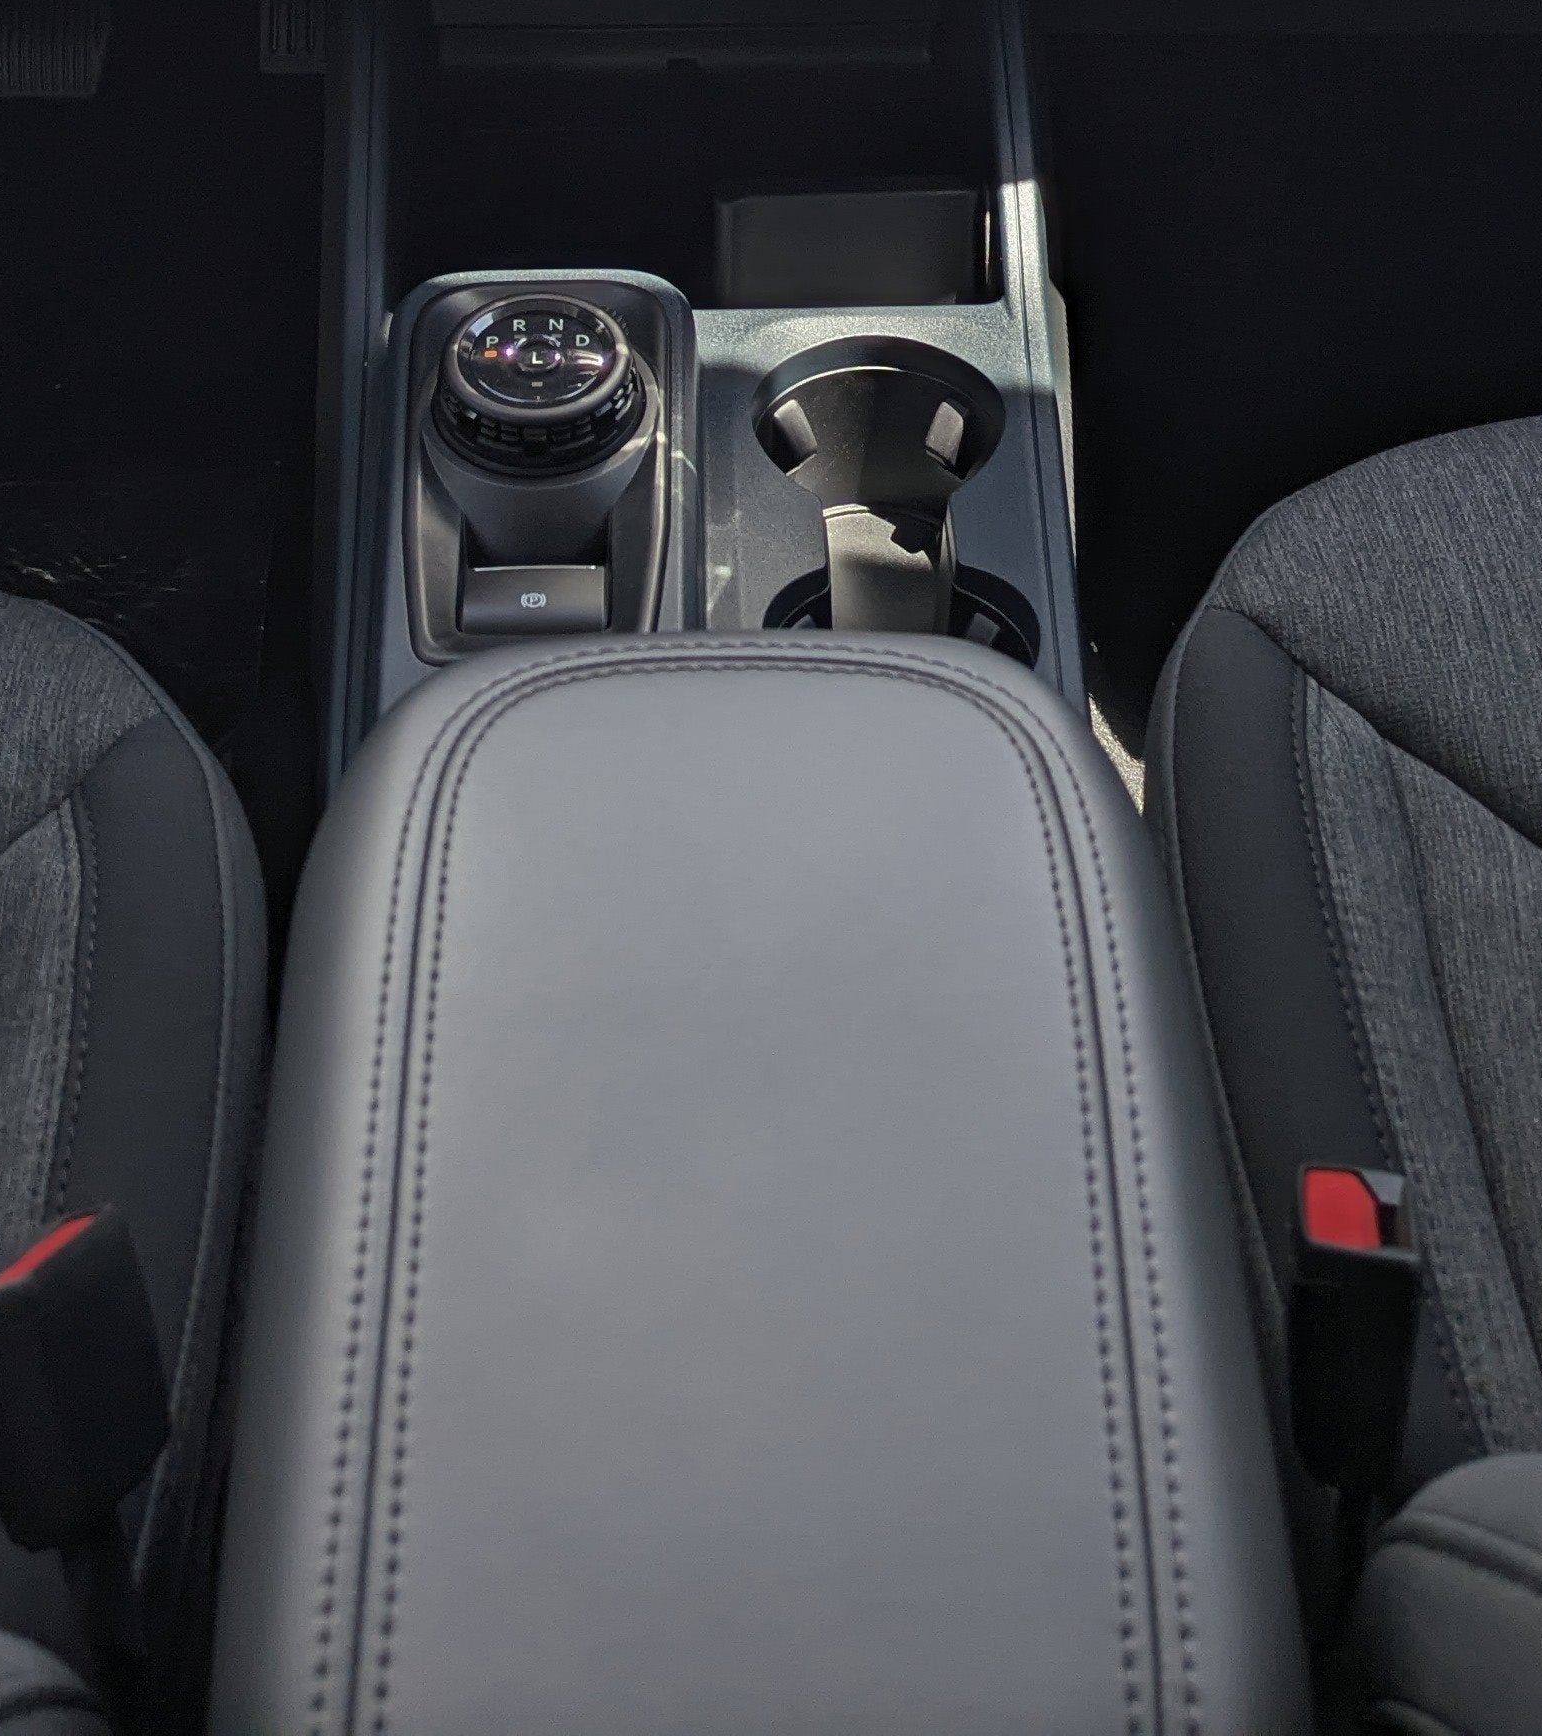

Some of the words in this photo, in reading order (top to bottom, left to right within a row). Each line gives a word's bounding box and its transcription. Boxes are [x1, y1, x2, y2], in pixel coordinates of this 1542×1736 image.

[512, 318, 527, 332] R
[548, 318, 564, 331] N
[486, 335, 499, 348] P
[575, 334, 590, 347] D
[531, 351, 544, 364] L
